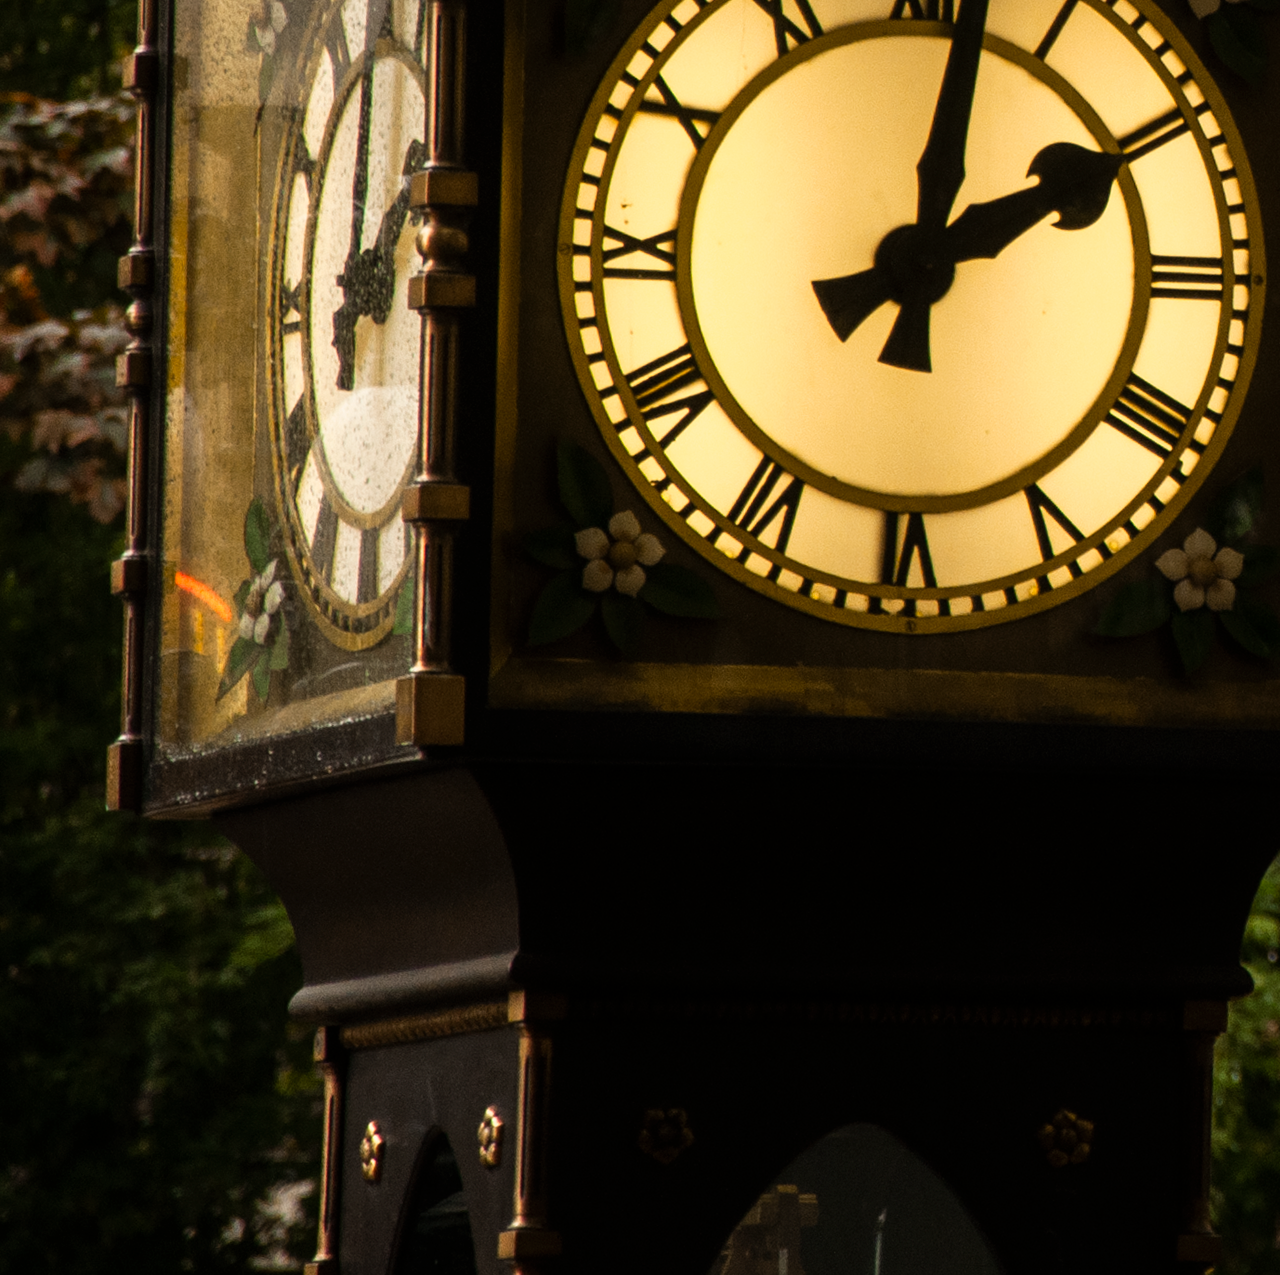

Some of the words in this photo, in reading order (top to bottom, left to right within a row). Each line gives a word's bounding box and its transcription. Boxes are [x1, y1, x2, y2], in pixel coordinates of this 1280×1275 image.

[638, 70, 721, 152] X
[602, 225, 675, 281] IX
[1150, 254, 1222, 302] III
[1023, 482, 1086, 562] V
